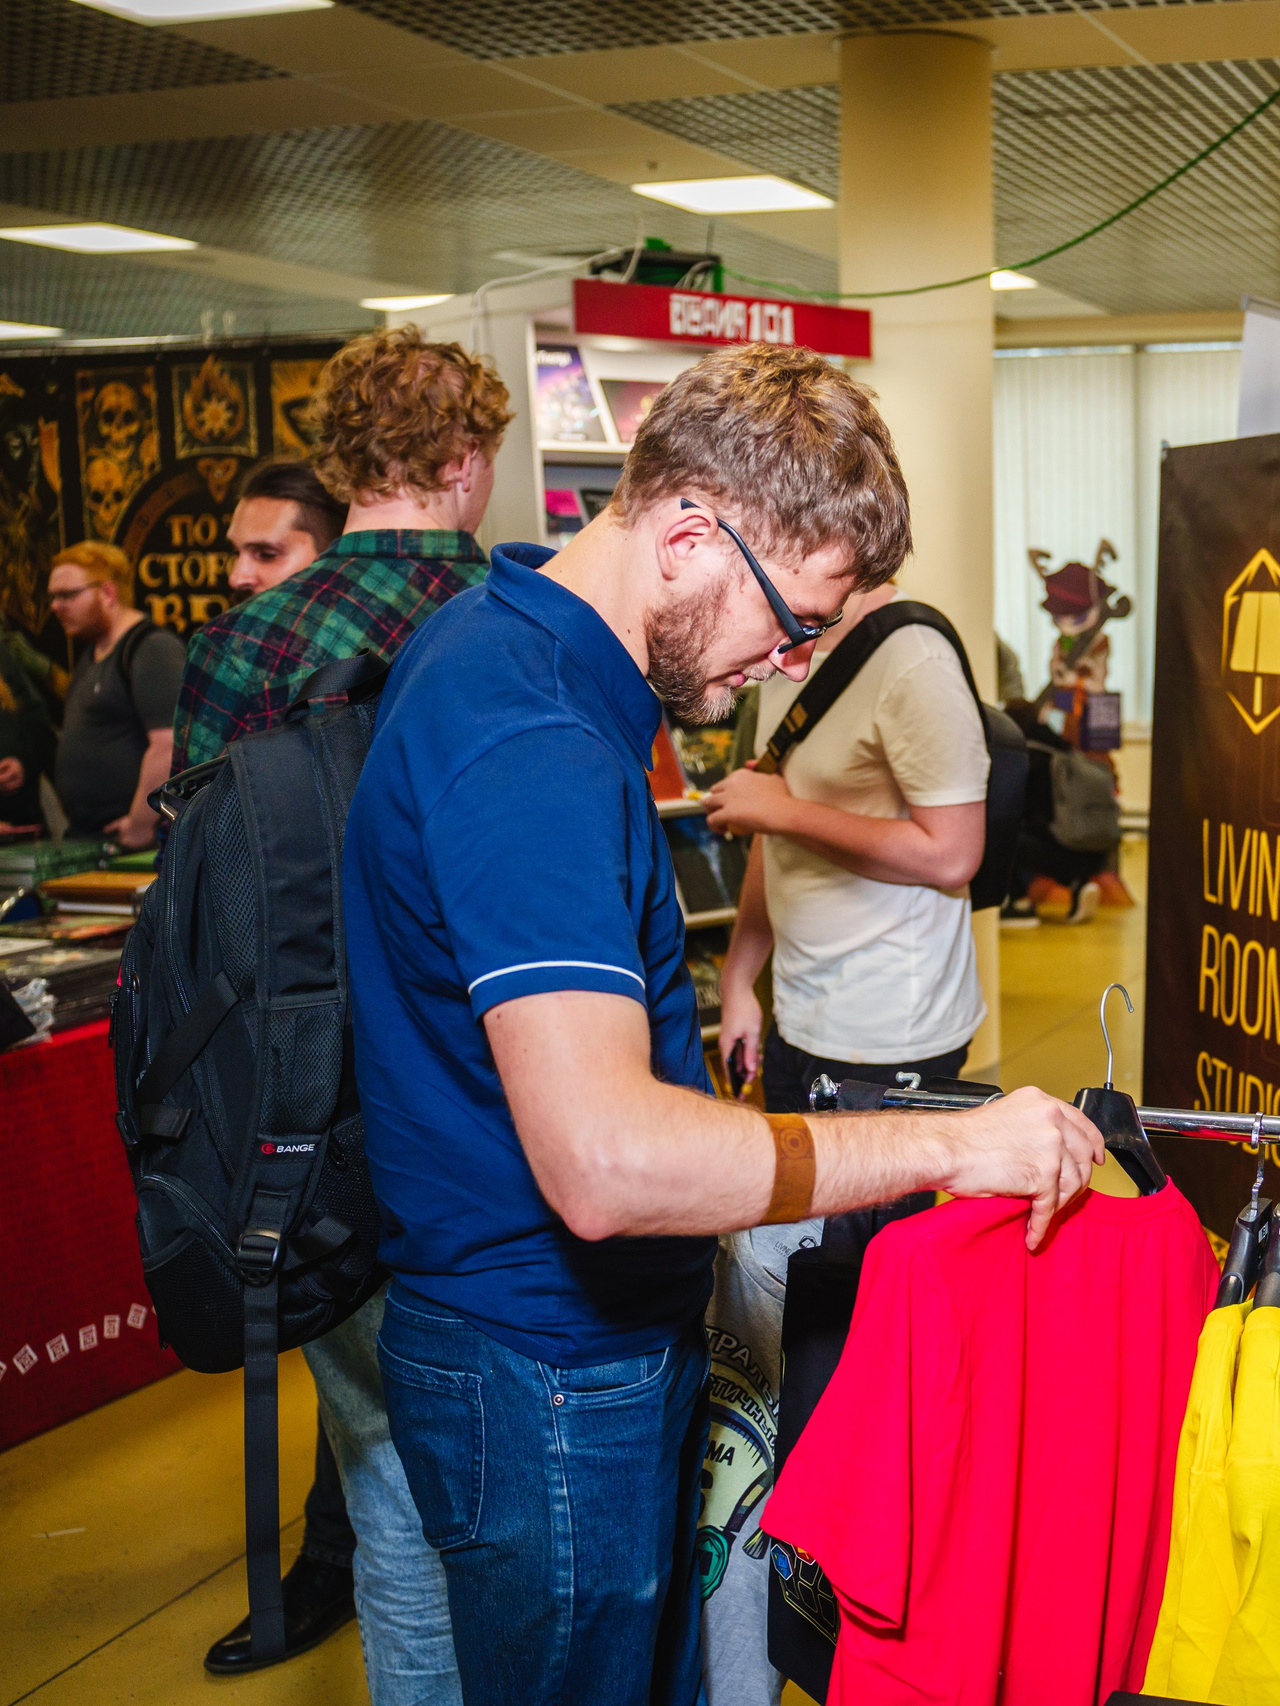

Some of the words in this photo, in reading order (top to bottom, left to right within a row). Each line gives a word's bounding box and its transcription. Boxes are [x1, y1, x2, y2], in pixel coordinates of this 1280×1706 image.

[166, 513, 218, 547] ПО
[276, 1143, 315, 1153] BANGE
[706, 1326, 779, 1415] ТРАЛЬ
